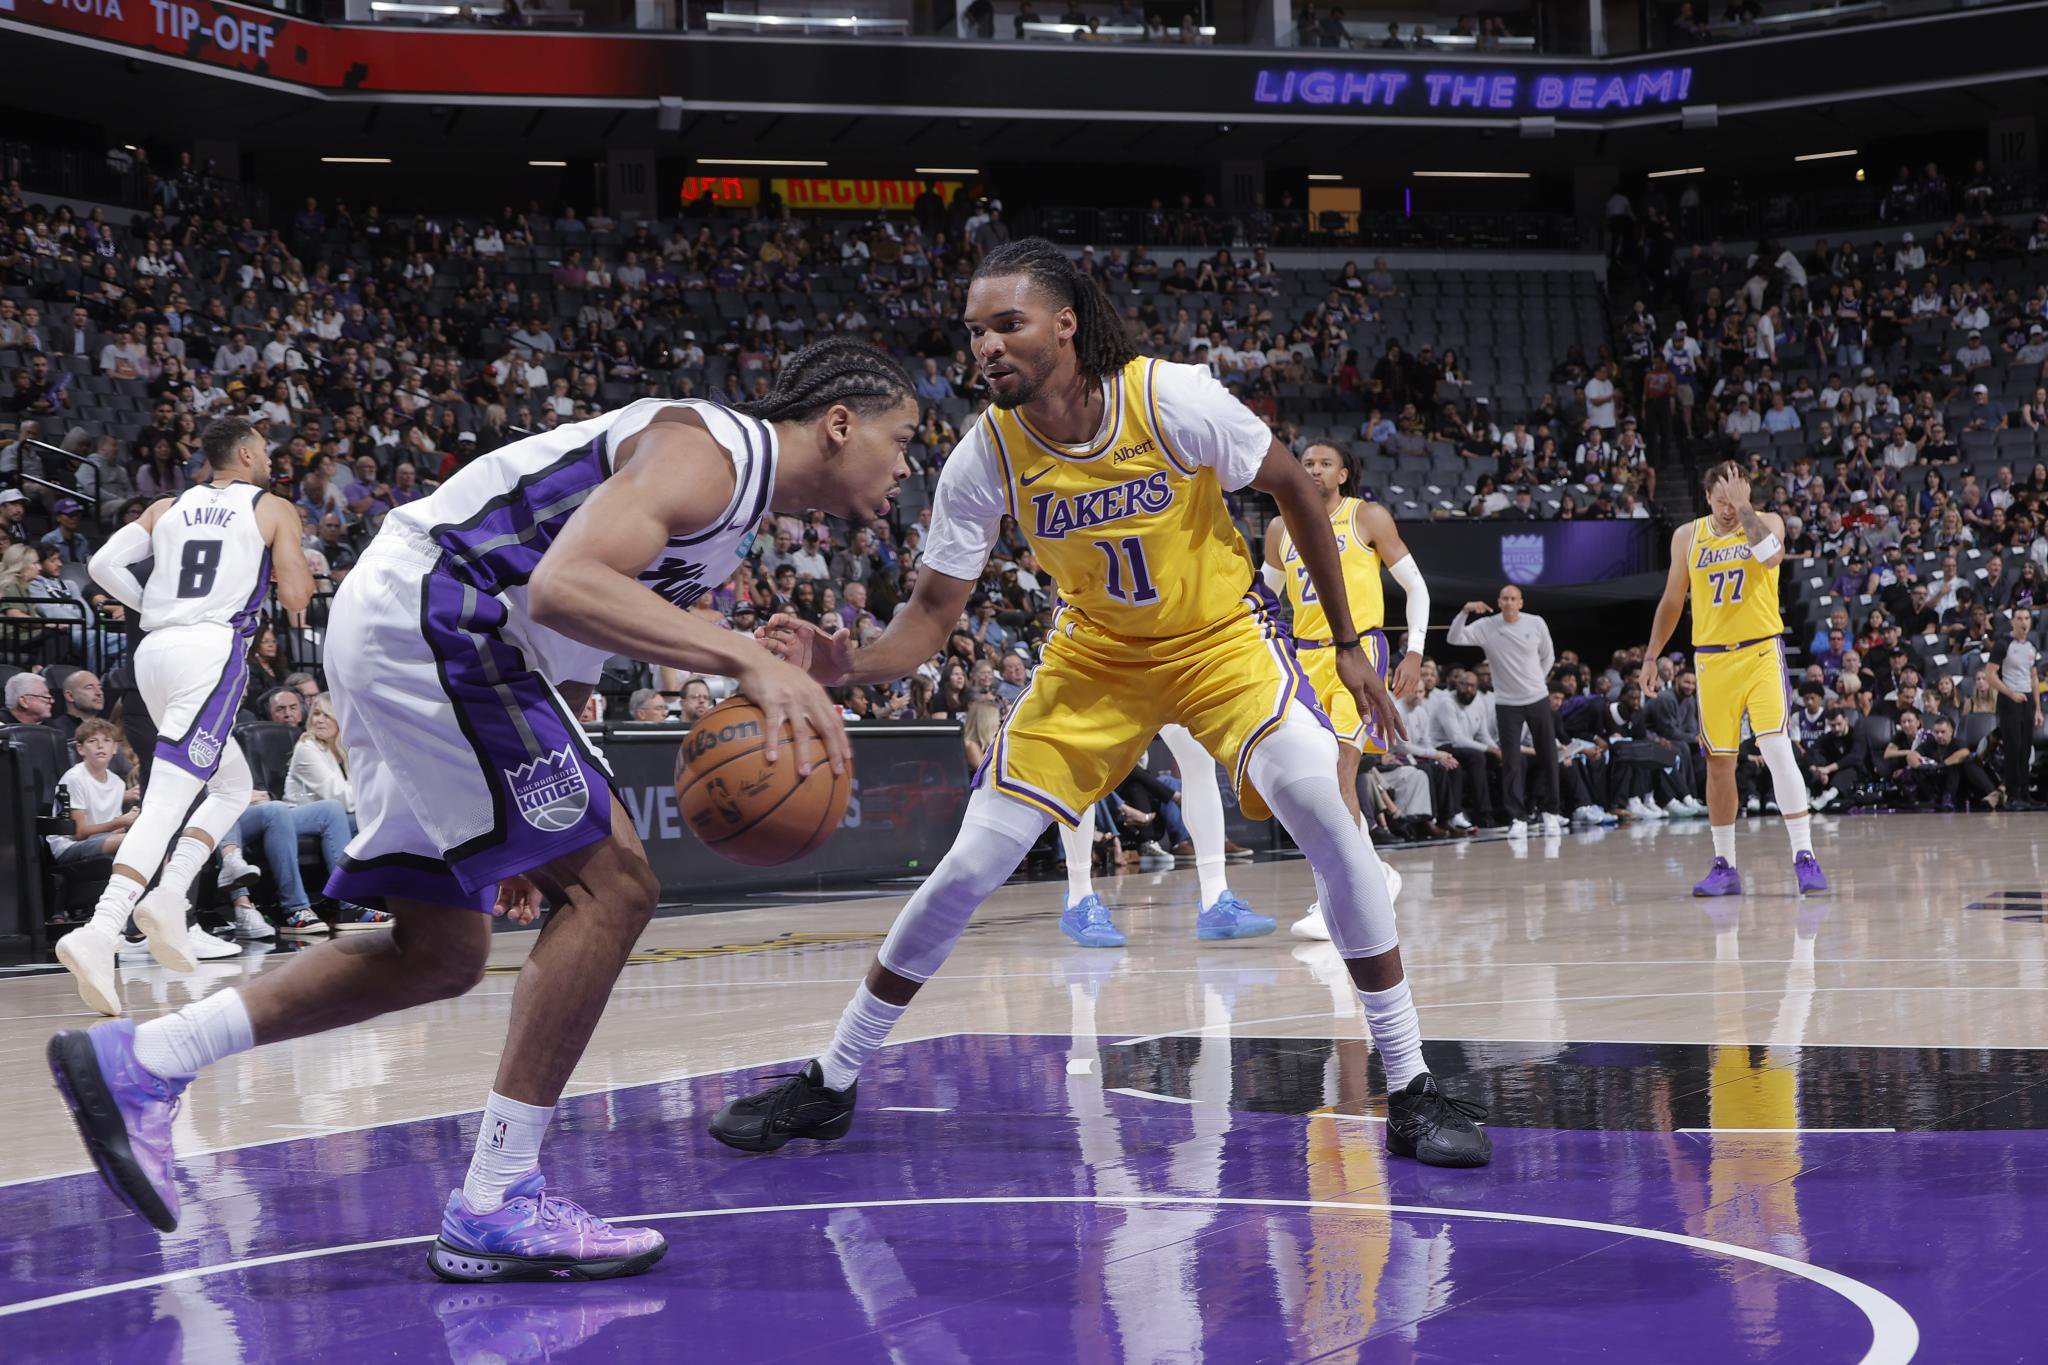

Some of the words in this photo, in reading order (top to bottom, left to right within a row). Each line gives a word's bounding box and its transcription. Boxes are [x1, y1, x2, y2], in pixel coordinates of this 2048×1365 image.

[152, 0, 274, 58] TIP-OFF
[1254, 71, 1406, 104] LIGHT
[1426, 75, 1518, 107] THE
[1537, 68, 1691, 108] BEAM!
[1113, 439, 1156, 464] Albert
[183, 507, 237, 528] LAVINE
[1031, 470, 1175, 540] LAKERS
[176, 539, 223, 598] 8
[1092, 535, 1160, 607] 11
[1695, 543, 1753, 569] LAKERS
[1708, 567, 1746, 608] 77
[516, 766, 577, 795] SACRAMENTO
[518, 776, 586, 814] KINGS
